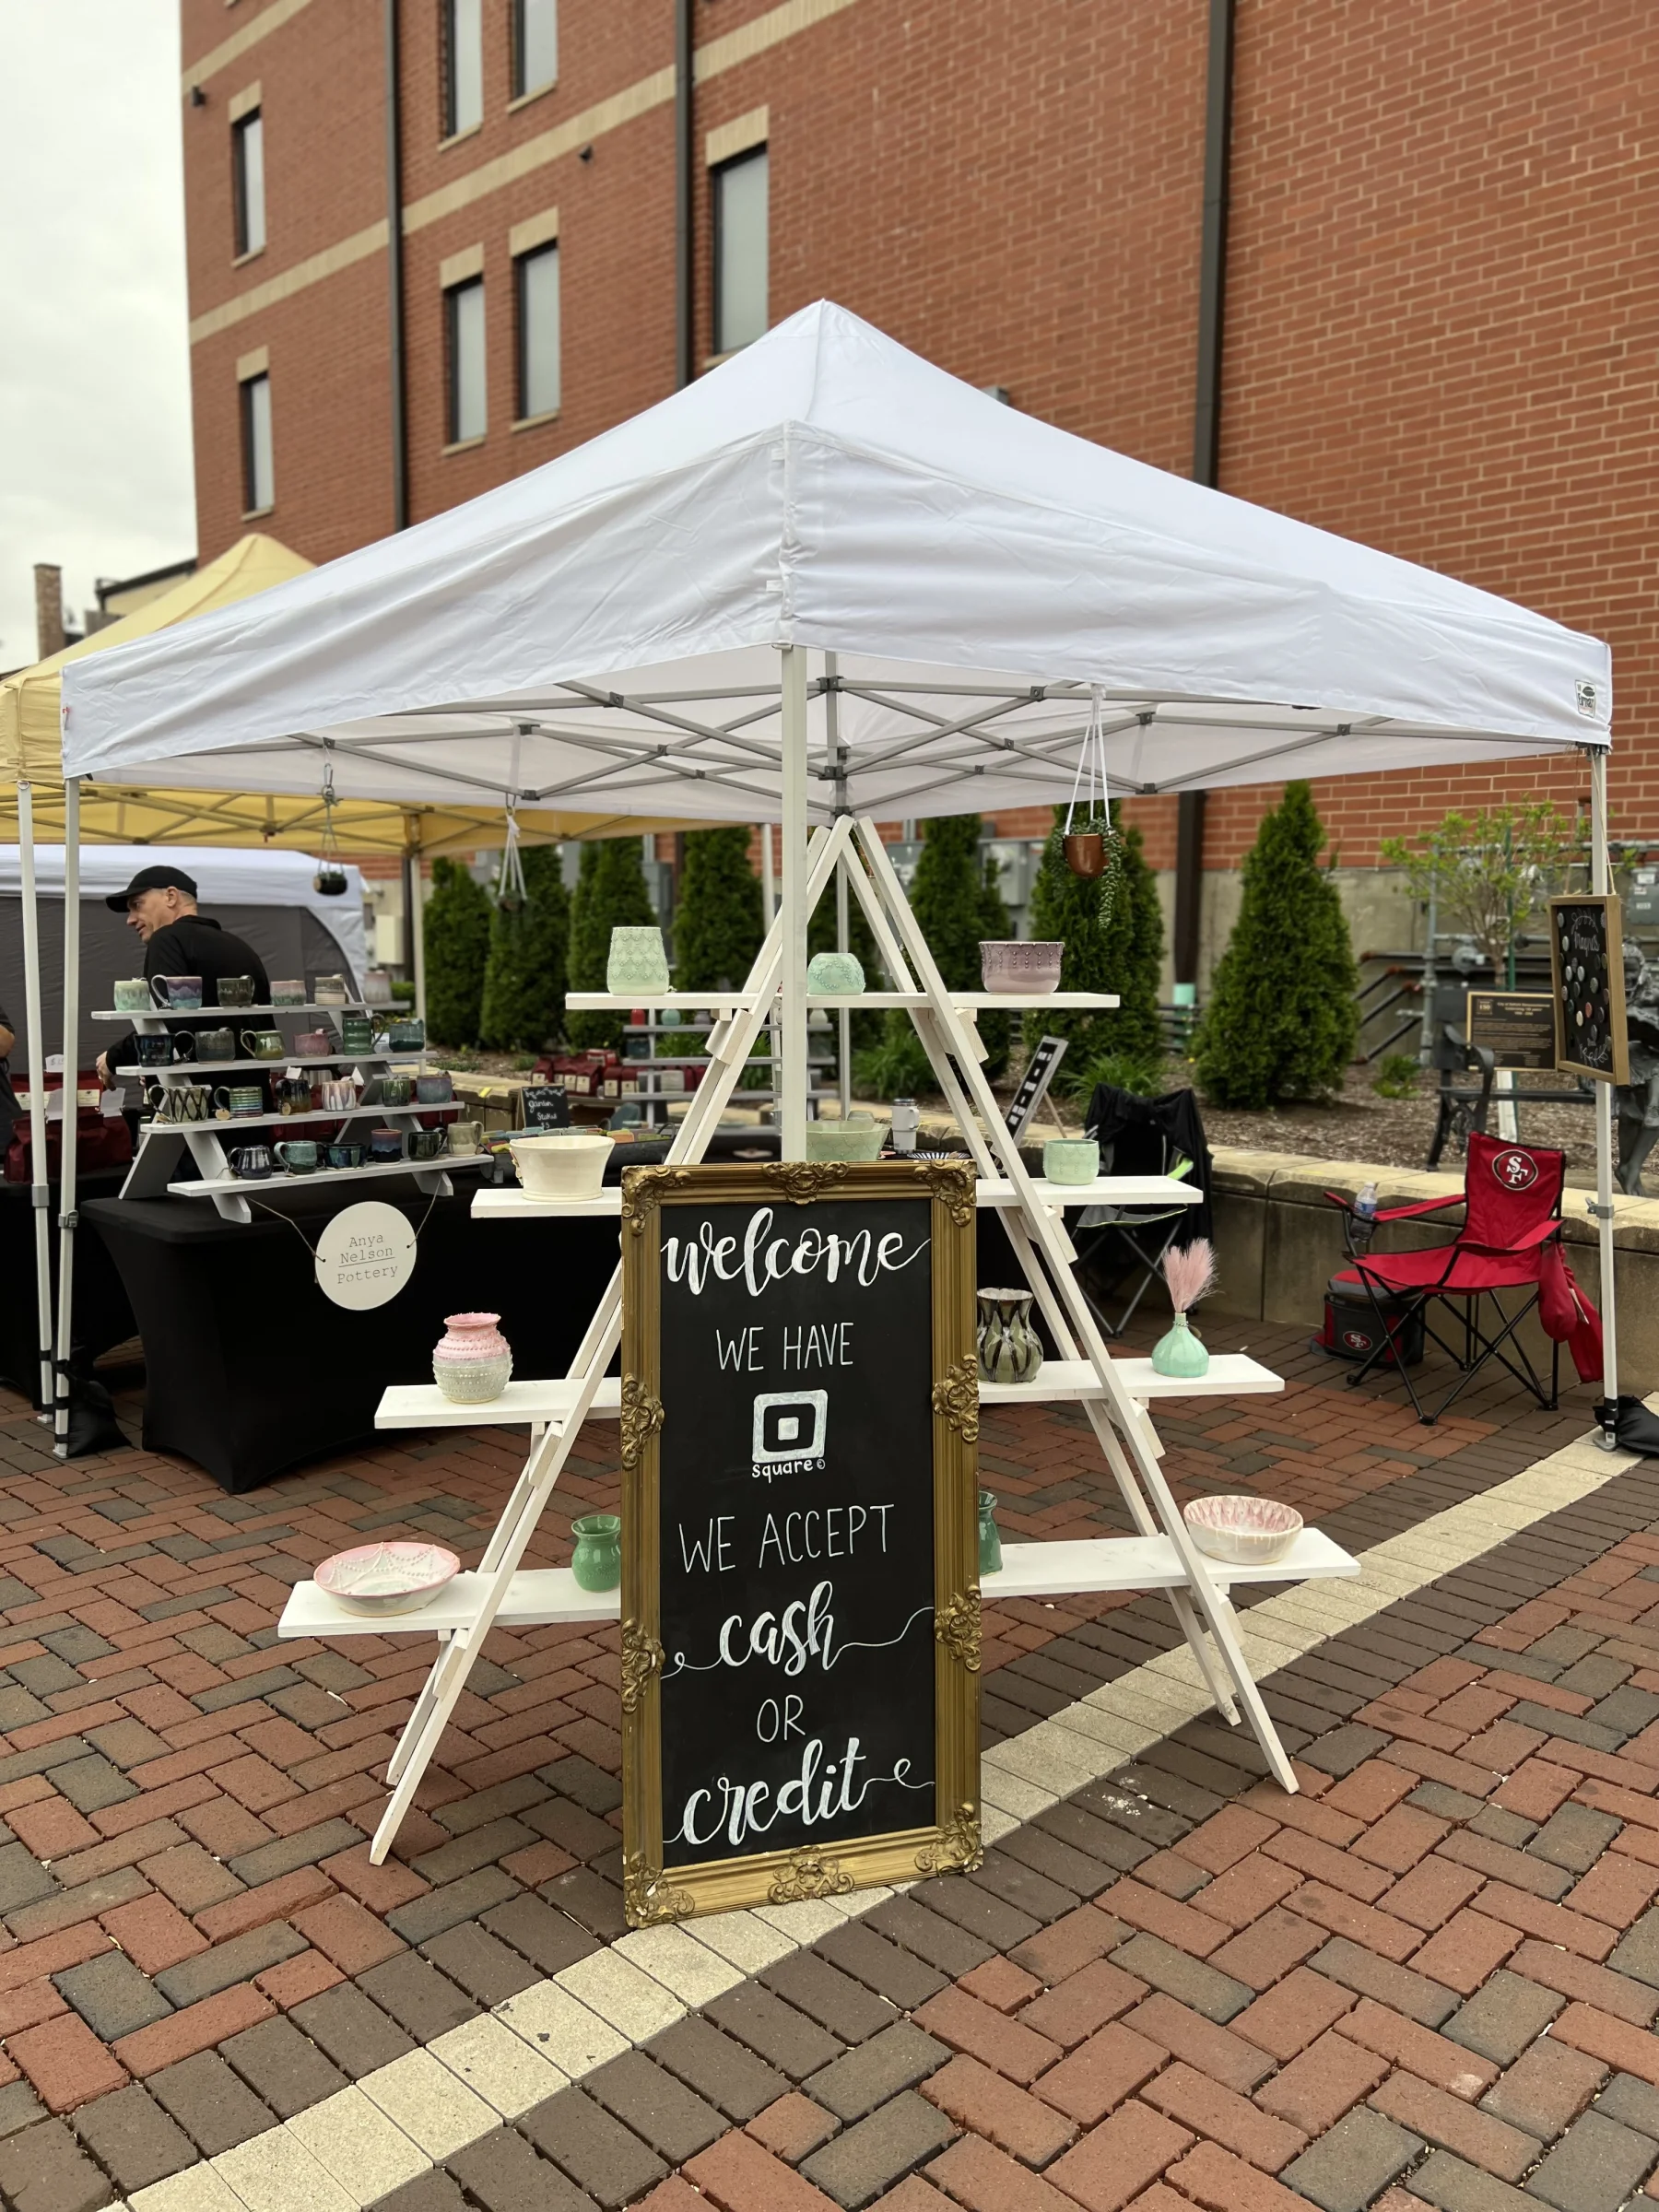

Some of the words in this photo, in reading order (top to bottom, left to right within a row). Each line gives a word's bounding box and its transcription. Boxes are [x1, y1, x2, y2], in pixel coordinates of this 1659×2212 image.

[340, 1247, 394, 1264] Nelson
[349, 1234, 384, 1248] Anya
[660, 1206, 932, 1297] welcome
[337, 1265, 398, 1285] Pottery
[715, 1326, 764, 1371] WE
[783, 1322, 854, 1370] HAVE
[678, 1515, 735, 1573] WE
[759, 1504, 895, 1569] ACCEPT
[706, 1581, 845, 1677] cash
[757, 1694, 806, 1742] OR
[663, 1737, 871, 1846] credit
